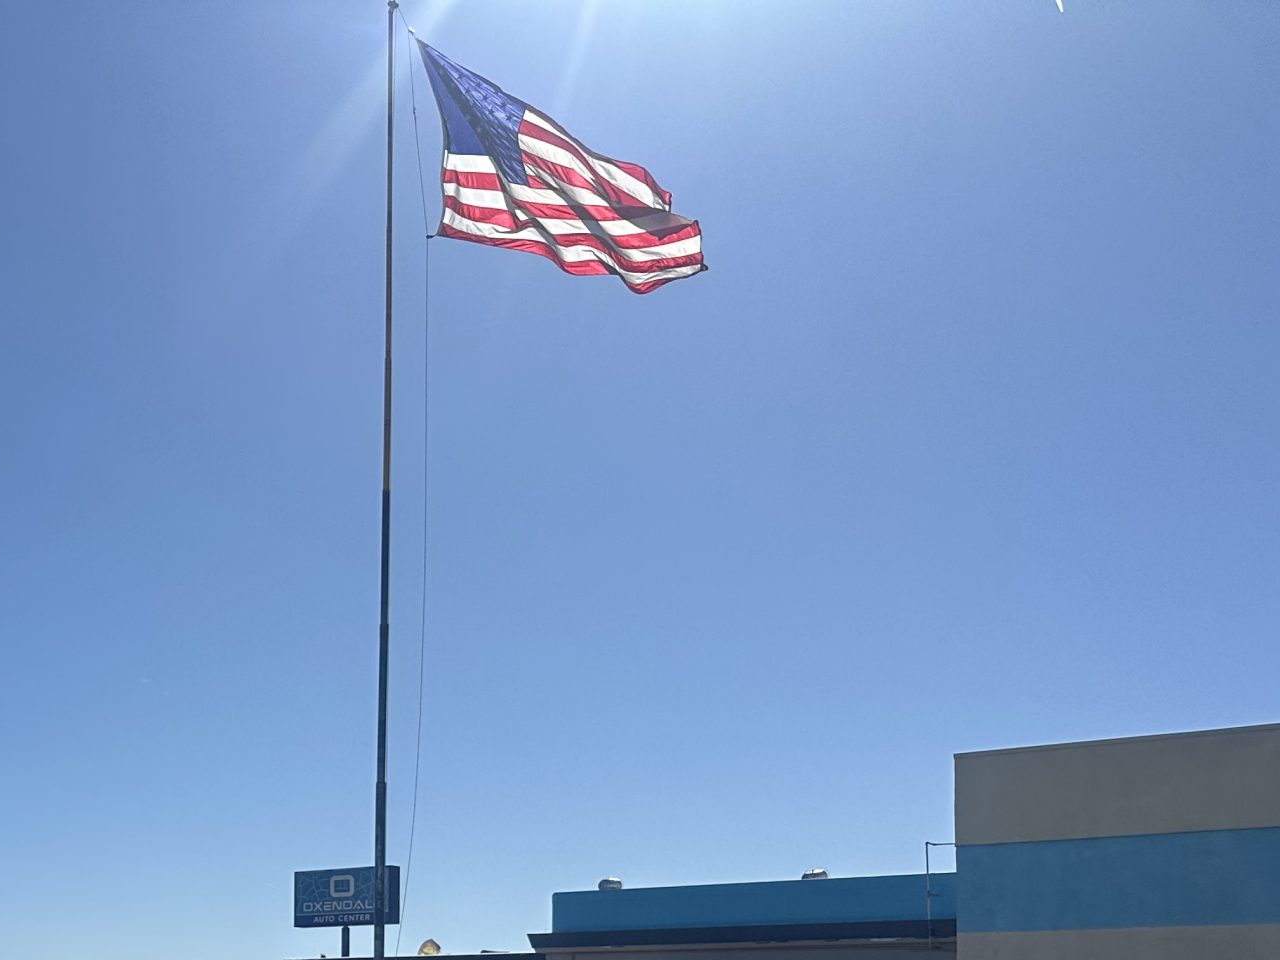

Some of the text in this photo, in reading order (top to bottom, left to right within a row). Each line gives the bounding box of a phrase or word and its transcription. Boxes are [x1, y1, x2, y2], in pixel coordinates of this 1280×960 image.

[303, 900, 375, 912] OXENDAL
[313, 914, 371, 923] AUTO CENTER
